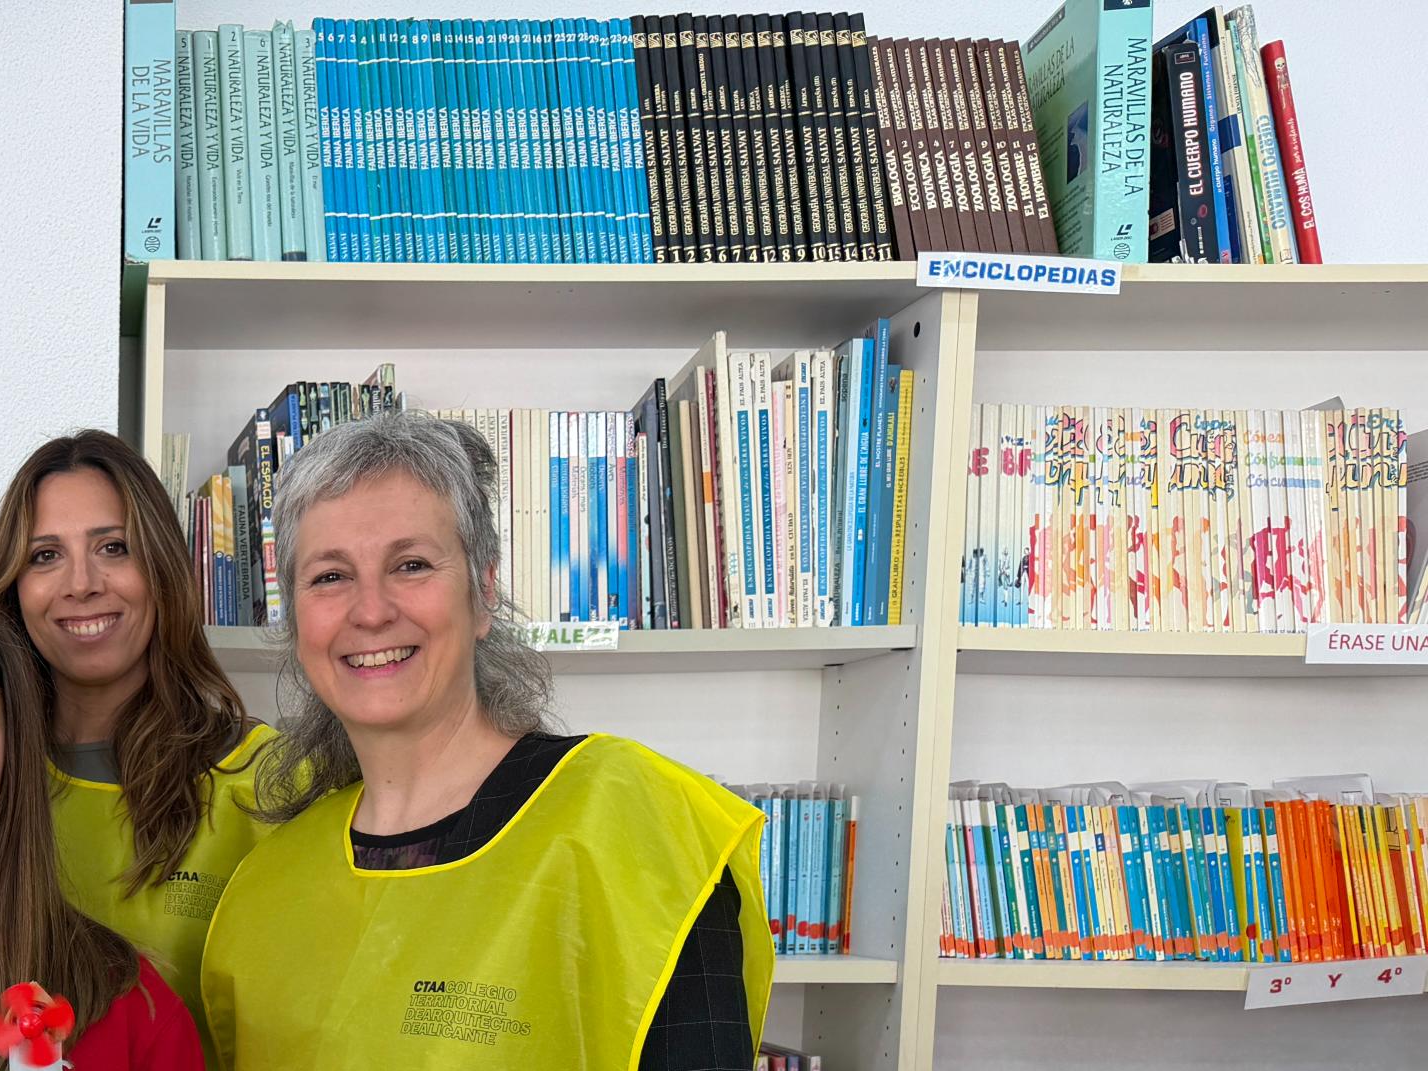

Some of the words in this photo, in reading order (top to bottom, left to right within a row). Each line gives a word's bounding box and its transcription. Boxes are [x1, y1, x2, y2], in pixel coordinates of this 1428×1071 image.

[132, 66, 150, 86] DE
[228, 50, 242, 123] NATURALEZA
[279, 42, 294, 116] NATURALEZA
[1125, 38, 1147, 143] MARAVILLAS
[132, 92, 150, 113] LA
[178, 56, 193, 130] NATURALEZA
[204, 57, 218, 130] NATURALEZA
[257, 55, 271, 129] NATURALEZA
[302, 56, 317, 129] NATURALEZA
[1180, 71, 1198, 127] HUMANO
[153, 59, 172, 163] MARAVILLAS
[282, 118, 294, 128] Y
[321, 106, 330, 138] IBERICA
[342, 107, 352, 139] IBERICA
[374, 109, 384, 140] IBERICA
[406, 109, 416, 140] IBERICA
[439, 107, 450, 138] IBERICA
[463, 109, 473, 139] IBERICA
[507, 108, 517, 139] IBERICA
[552, 108, 562, 139] IBERICA
[1102, 64, 1123, 174] NATURALEZA
[132, 118, 150, 158] VIDA
[181, 133, 193, 142] Y
[207, 133, 218, 142] Y
[231, 126, 242, 135] Y
[260, 132, 271, 142] Y
[282, 130, 296, 156] VIDA
[305, 132, 318, 142] Y
[692, 128, 704, 164] SALVAT
[770, 128, 782, 164] SALVAT
[803, 126, 815, 162] SALVAT
[866, 128, 878, 164] SALVAT
[1257, 115, 1277, 167] CUERPO
[181, 144, 194, 170] VIDA
[206, 144, 219, 170] VIDA
[231, 137, 243, 163] VIDA
[260, 144, 273, 169] VIDA
[306, 144, 319, 170] VIDA
[323, 140, 332, 167] FAUNA
[345, 141, 354, 168] FAUNA
[377, 142, 386, 169] FAUNA
[408, 142, 418, 169] FAUNA
[442, 140, 452, 167] FAUNA
[465, 142, 475, 168] FAUNA
[510, 141, 520, 168] FAUNA
[555, 141, 565, 168] FAUNA
[660, 128, 672, 165] SALVAT
[676, 129, 688, 165] SALVAT
[721, 129, 733, 165] SALVAT
[1125, 148, 1145, 169] DE
[1184, 129, 1203, 179] CUERPO
[664, 166, 675, 200] UNIVERSAL
[680, 166, 690, 200] UNIVERSAL
[696, 165, 707, 199] UNIVERSAL
[725, 166, 736, 200] UNIVERSAL
[774, 165, 785, 199] UNIVERSAL
[807, 163, 818, 197] UNIVERSAL
[871, 165, 882, 198] UNIVERSAL
[1014, 151, 1032, 200] HOMBRE
[1028, 153, 1046, 202] HOMBRE
[1124, 175, 1144, 196] LA
[1189, 180, 1203, 195] EL
[1024, 201, 1035, 217] EL
[1038, 203, 1050, 219] EL
[1264, 169, 1286, 229] HUMANO
[1298, 195, 1312, 217] COS
[1303, 217, 1314, 230] EL
[928, 260, 1117, 287] ENCICLOPEDIAS
[260, 445, 270, 458] EL
[860, 456, 868, 464] DE
[261, 460, 273, 509] ESPACIO
[858, 487, 867, 505] GRAN
[238, 505, 248, 537] FAUNA
[239, 539, 250, 600] VERTEBRADA
[1328, 630, 1386, 651] ÉRASE
[1327, 973, 1343, 988] Y
[409, 994, 508, 1016] TERRITORIAL
[400, 1021, 497, 1045] DEALICANTE
[404, 1007, 531, 1036] DEARQUITECTOS
